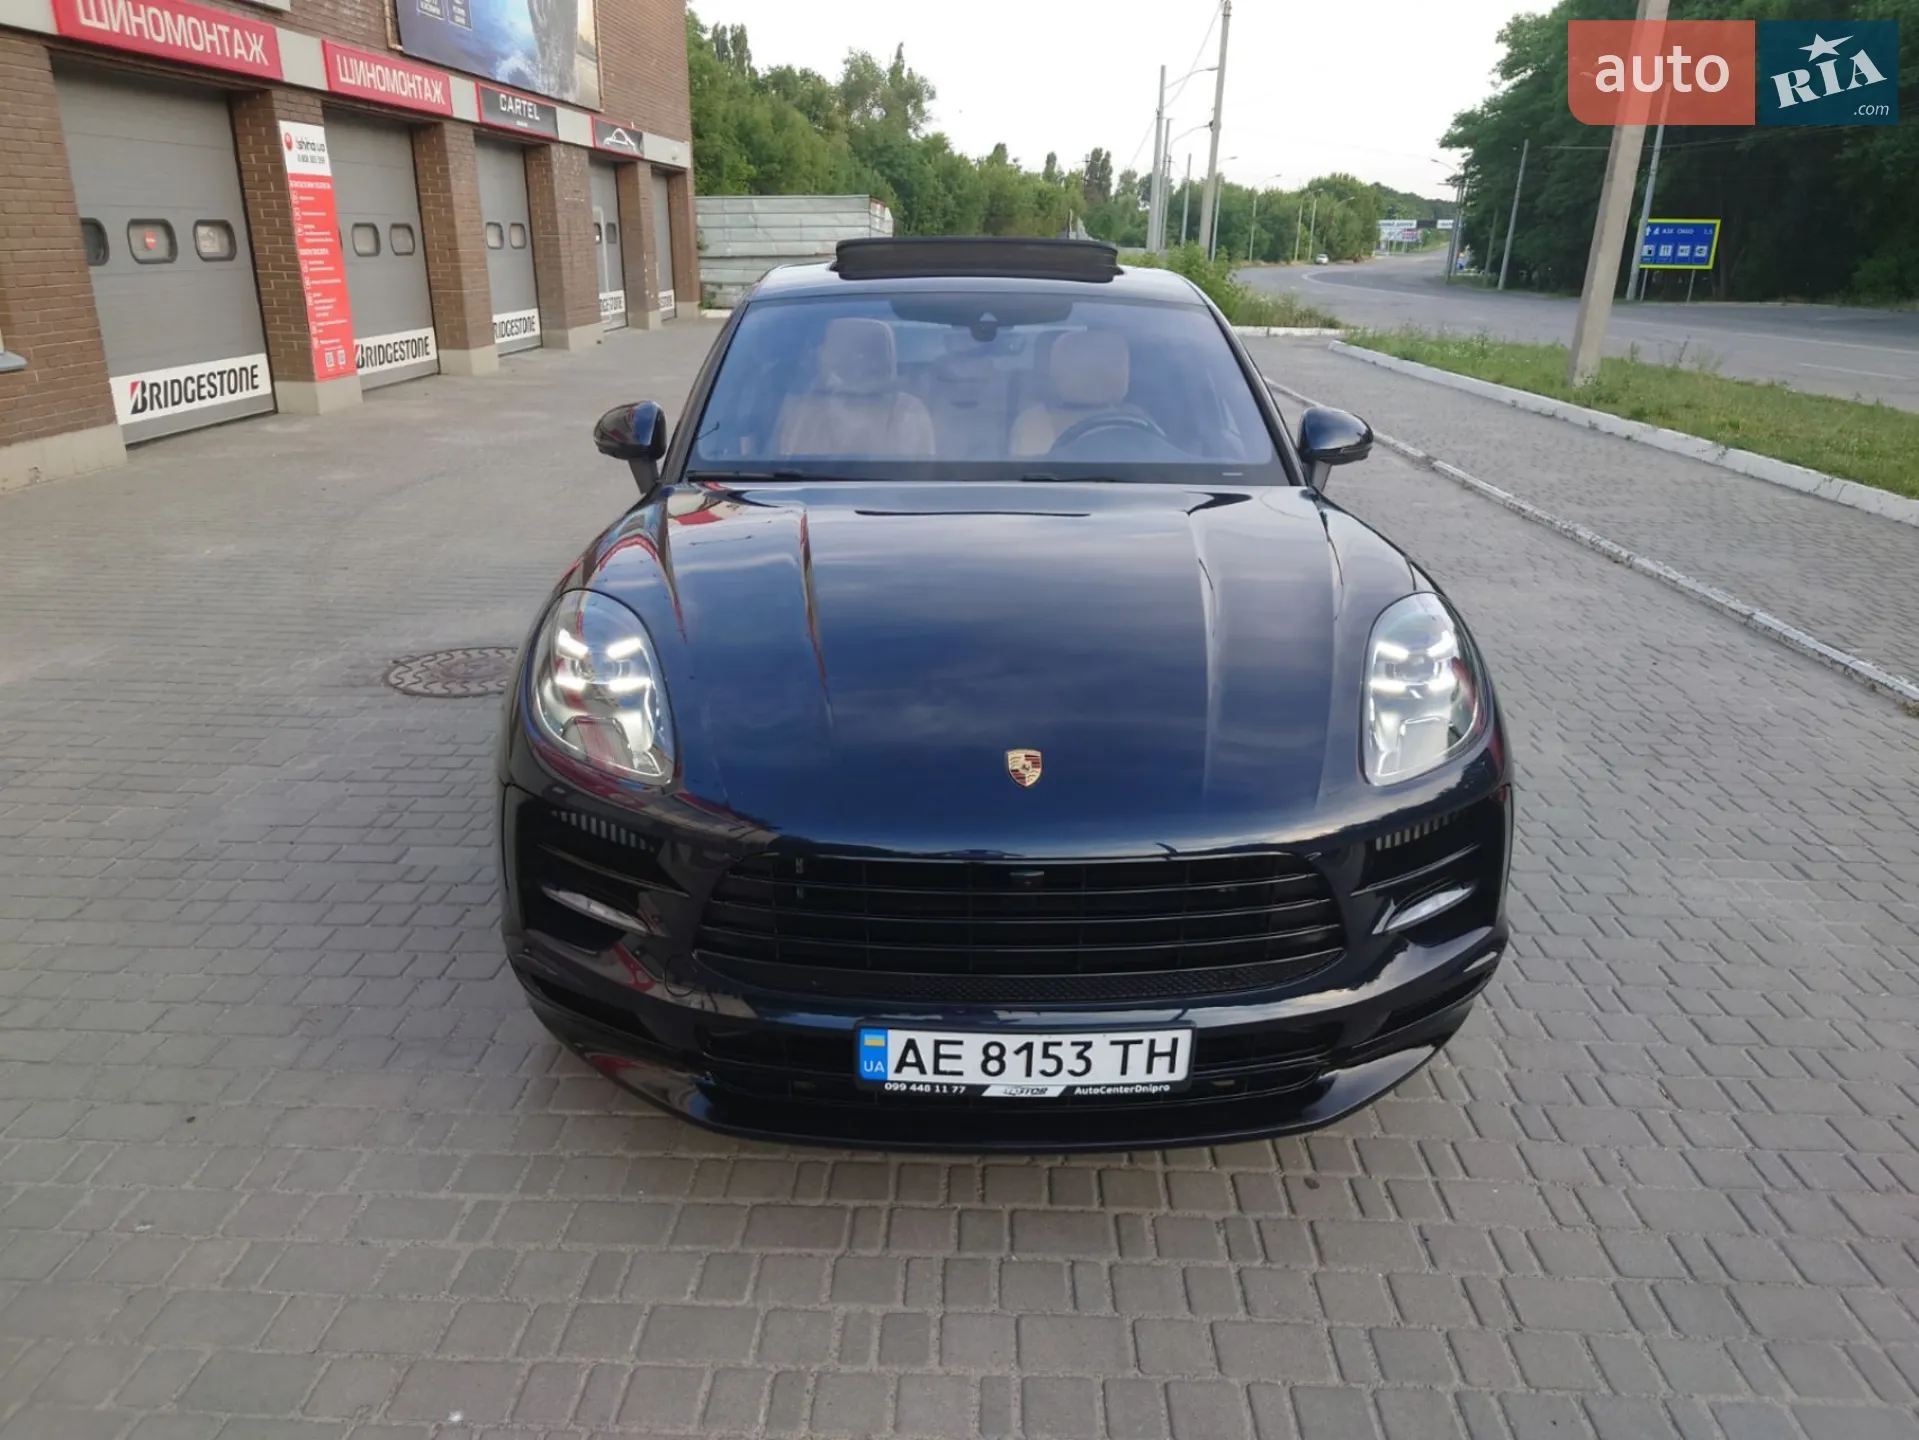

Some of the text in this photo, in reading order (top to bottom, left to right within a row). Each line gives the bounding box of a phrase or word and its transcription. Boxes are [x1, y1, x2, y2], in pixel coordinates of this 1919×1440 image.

[77, 0, 269, 66] ШИНОМОНТАЖ
[336, 54, 446, 105] ШИНОМОНТАЖ
[499, 93, 541, 121] CARTEL
[492, 315, 536, 339] RIDGESTONE
[355, 336, 430, 369] BRIDGESTONE
[130, 364, 259, 415] BRIDGESTONE
[864, 1060, 885, 1073] UA
[893, 1037, 1180, 1078] AE 8153 TH
[884, 1082, 907, 1092] 099
[1074, 1084, 1170, 1096] AutoCenterDnipro
